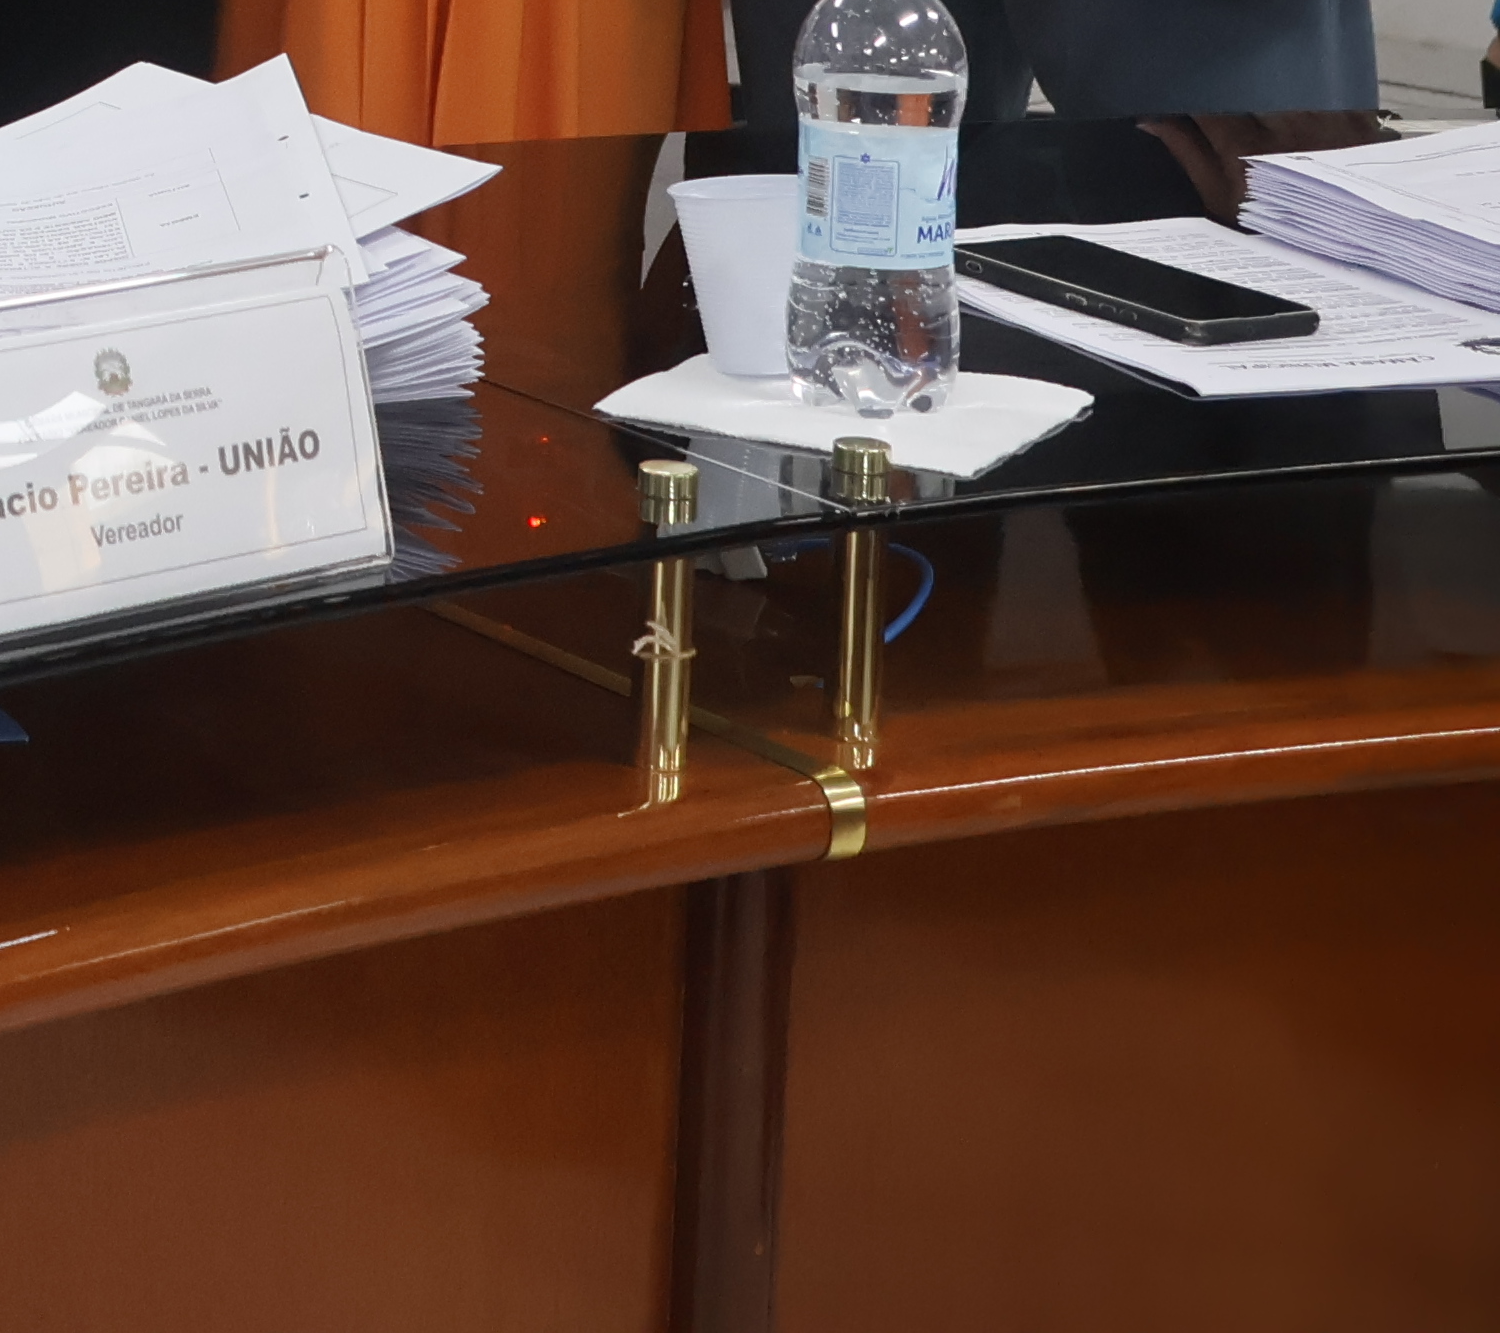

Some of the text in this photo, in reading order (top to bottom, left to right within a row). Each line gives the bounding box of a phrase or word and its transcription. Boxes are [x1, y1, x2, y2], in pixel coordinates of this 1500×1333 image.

[67, 460, 190, 506] Pereira
[217, 427, 320, 476] UNIÃO
[91, 512, 184, 549] Vereador
